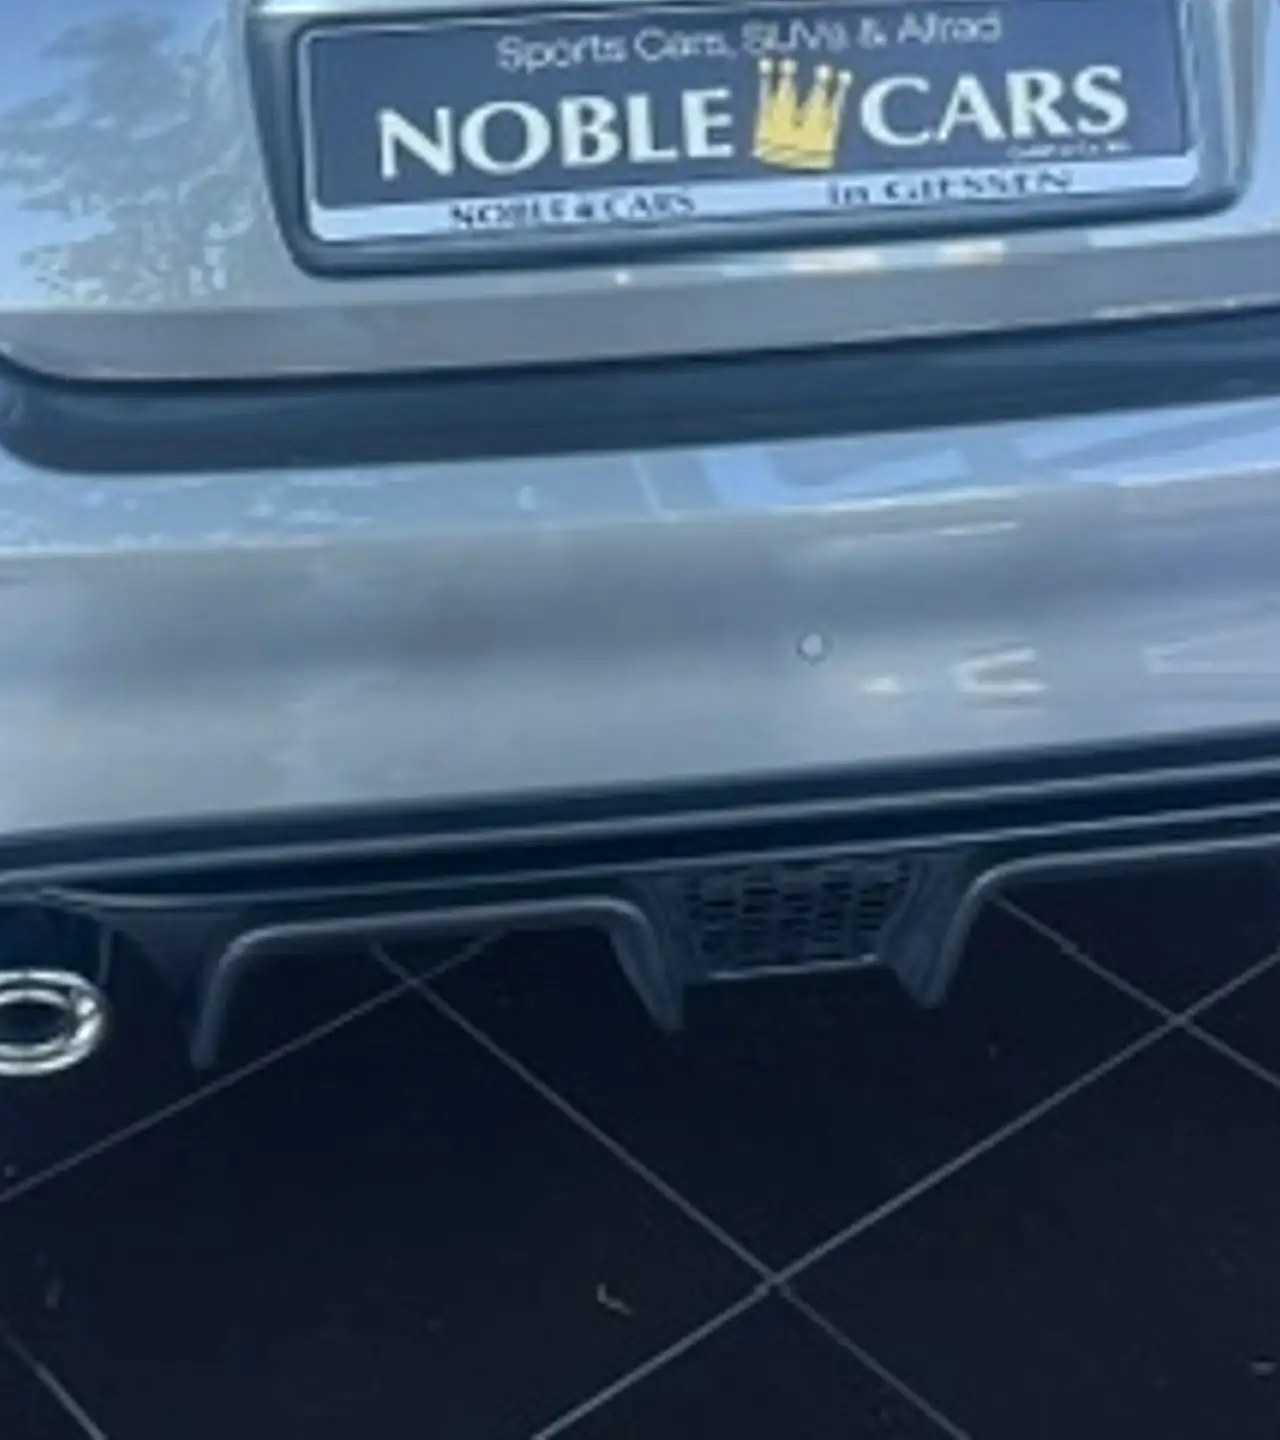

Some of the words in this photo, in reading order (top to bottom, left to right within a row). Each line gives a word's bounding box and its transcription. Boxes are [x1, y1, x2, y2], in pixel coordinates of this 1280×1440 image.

[496, 34, 627, 75] Sports
[856, 17, 888, 50] &
[376, 86, 736, 181] NOBLE
[859, 63, 1130, 148] CARS
